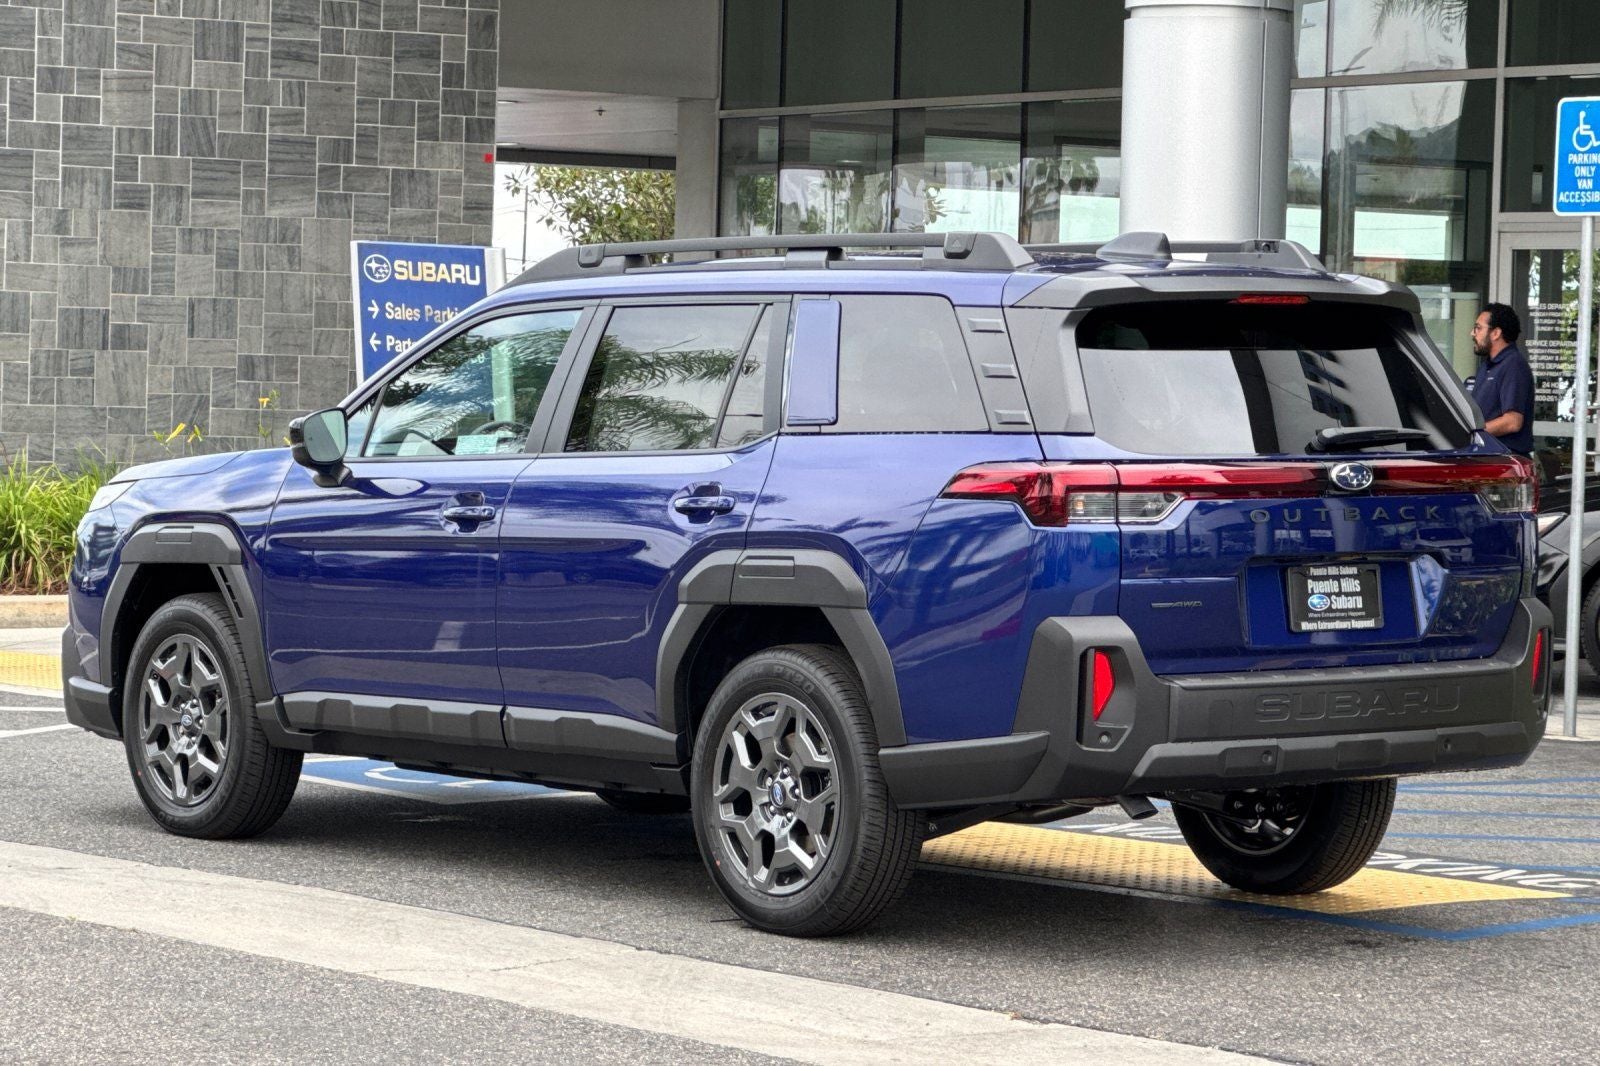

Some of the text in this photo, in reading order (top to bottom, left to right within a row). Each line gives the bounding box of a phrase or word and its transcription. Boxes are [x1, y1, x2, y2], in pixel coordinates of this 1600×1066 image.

[1574, 166, 1596, 177] ONLY
[1577, 178, 1593, 189] VAN
[1558, 191, 1600, 203] ACCESSIB
[393, 259, 481, 286] SUBARU
[385, 301, 421, 321] Sales
[1250, 505, 1440, 524] OUTBACK
[1340, 566, 1358, 575] Subaru
[1307, 577, 1361, 594] Puente Hills
[1331, 594, 1363, 610] Subaru
[1255, 685, 1461, 723] SUBARU
